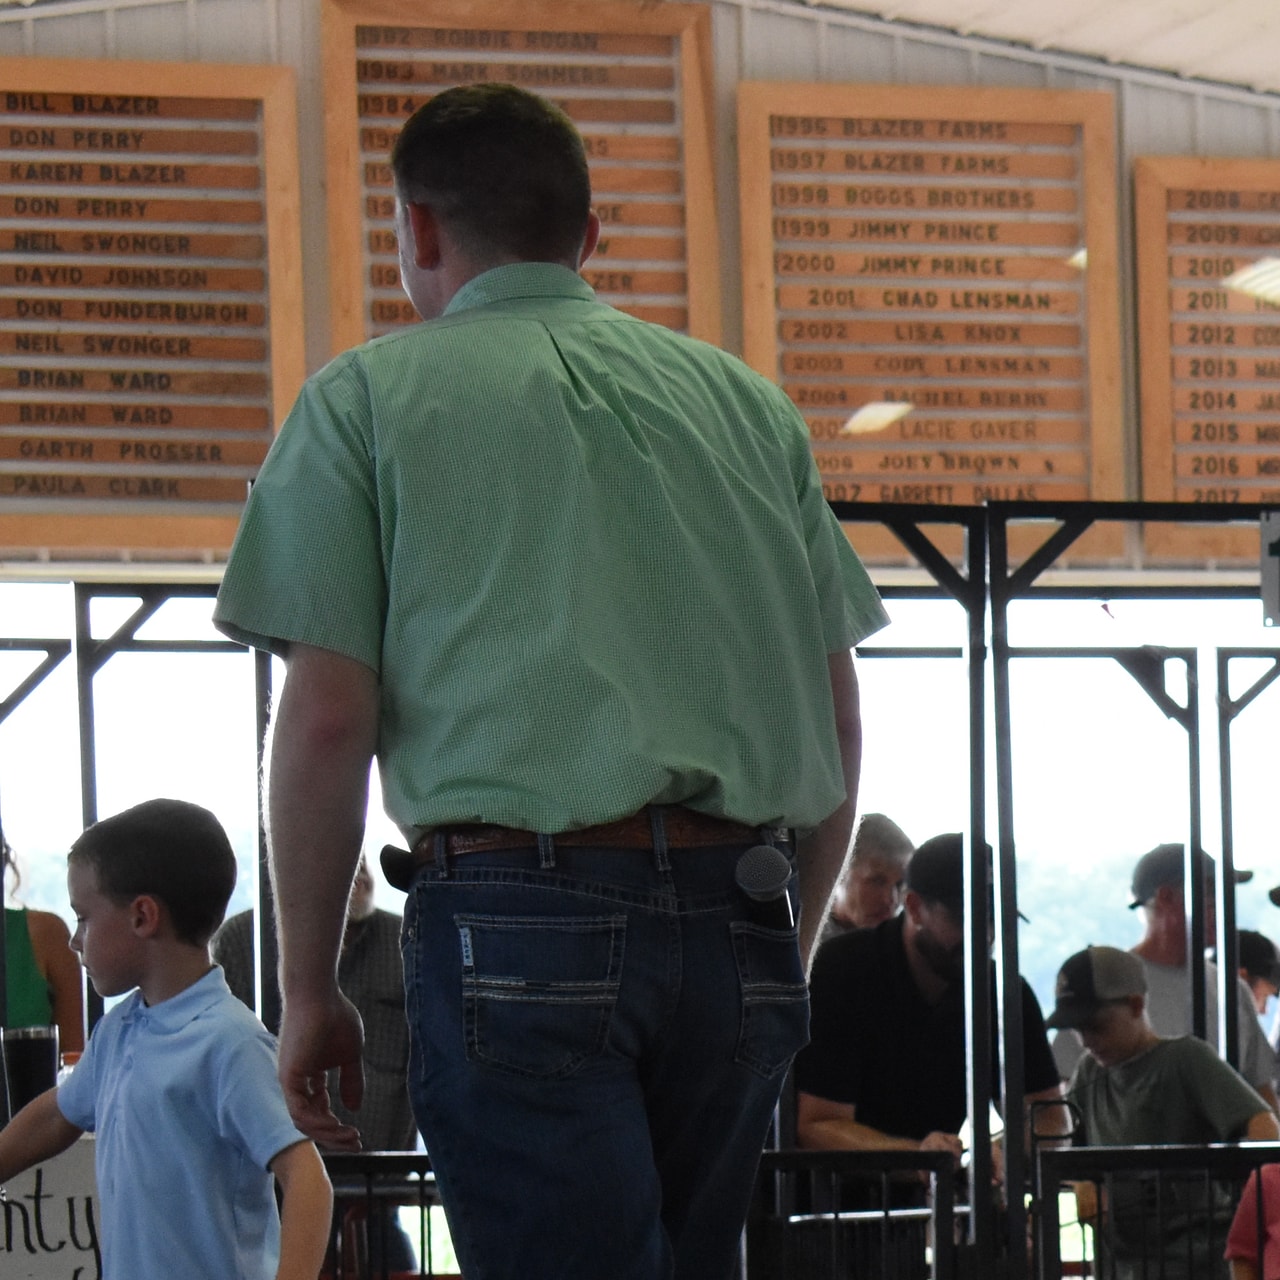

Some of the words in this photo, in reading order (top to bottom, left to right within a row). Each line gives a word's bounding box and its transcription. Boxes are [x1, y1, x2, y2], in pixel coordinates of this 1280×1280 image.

[6, 95, 55, 112] BILL
[73, 97, 159, 114] BLAZER
[360, 96, 415, 114] 1984
[843, 118, 924, 137] BLAZER
[938, 121, 1008, 139] FARMS
[10, 130, 56, 146] DON
[73, 131, 145, 148] PERRY
[778, 151, 825, 169] 1997
[845, 153, 924, 172] BLAZER
[941, 156, 1009, 174] FARMS
[10, 163, 83, 181] KAREN
[100, 165, 186, 182] BLAZER
[14, 198, 59, 214] DON
[77, 199, 147, 217] PERRY
[928, 189, 1034, 209] BROTHERS
[1186, 190, 1240, 209] 2008
[780, 219, 830, 237] 1999
[849, 222, 910, 239] JIMMY
[925, 223, 999, 241] PRINCE
[1187, 225, 1239, 243] 2009
[14, 234, 62, 250] NEIL
[82, 234, 191, 253] SWONGER
[782, 254, 835, 272] 2000
[860, 256, 921, 273] JIMMY
[931, 258, 1006, 275] PRINCE
[1188, 258, 1235, 276] 2010
[16, 267, 82, 284] DAVID
[103, 268, 208, 286] JOHNSON
[809, 288, 856, 306] 2001
[882, 290, 938, 307] CHAD
[951, 291, 1051, 309] LENSMAN
[1188, 291, 1228, 309] 2011
[16, 300, 62, 317] DON
[793, 322, 848, 340] 2002
[894, 325, 944, 341] LISA
[965, 326, 1021, 342] KNOX
[1188, 325, 1235, 344] 2012
[16, 336, 64, 352] NEIL
[83, 336, 191, 355] SWONGER
[794, 356, 843, 372] 2003
[874, 357, 925, 373] CODY
[945, 358, 1051, 374] LENSMAN
[1190, 358, 1236, 377] 2013
[18, 370, 84, 388] BRIAN
[110, 373, 171, 390] WARD
[798, 389, 847, 405] 2004
[883, 389, 964, 406] RACHEL
[1190, 391, 1236, 409] 2014
[19, 404, 86, 423] BRIAN
[112, 407, 173, 424] WARD
[901, 421, 955, 439] LACIE
[971, 422, 1037, 440] GAVER
[1192, 422, 1239, 442] 2015
[20, 440, 93, 457] GARTH
[120, 444, 222, 462] PROSSER
[815, 454, 853, 470] 006
[879, 455, 931, 470] JOEY
[943, 455, 1019, 472] BROWN
[1192, 455, 1239, 475] 2016
[13, 475, 86, 494] PAULA
[109, 478, 180, 496] CLARK
[820, 485, 861, 502] 007
[880, 485, 953, 504] GARRETT
[973, 486, 1038, 504] DALLAS
[1194, 487, 1239, 503] 2017
